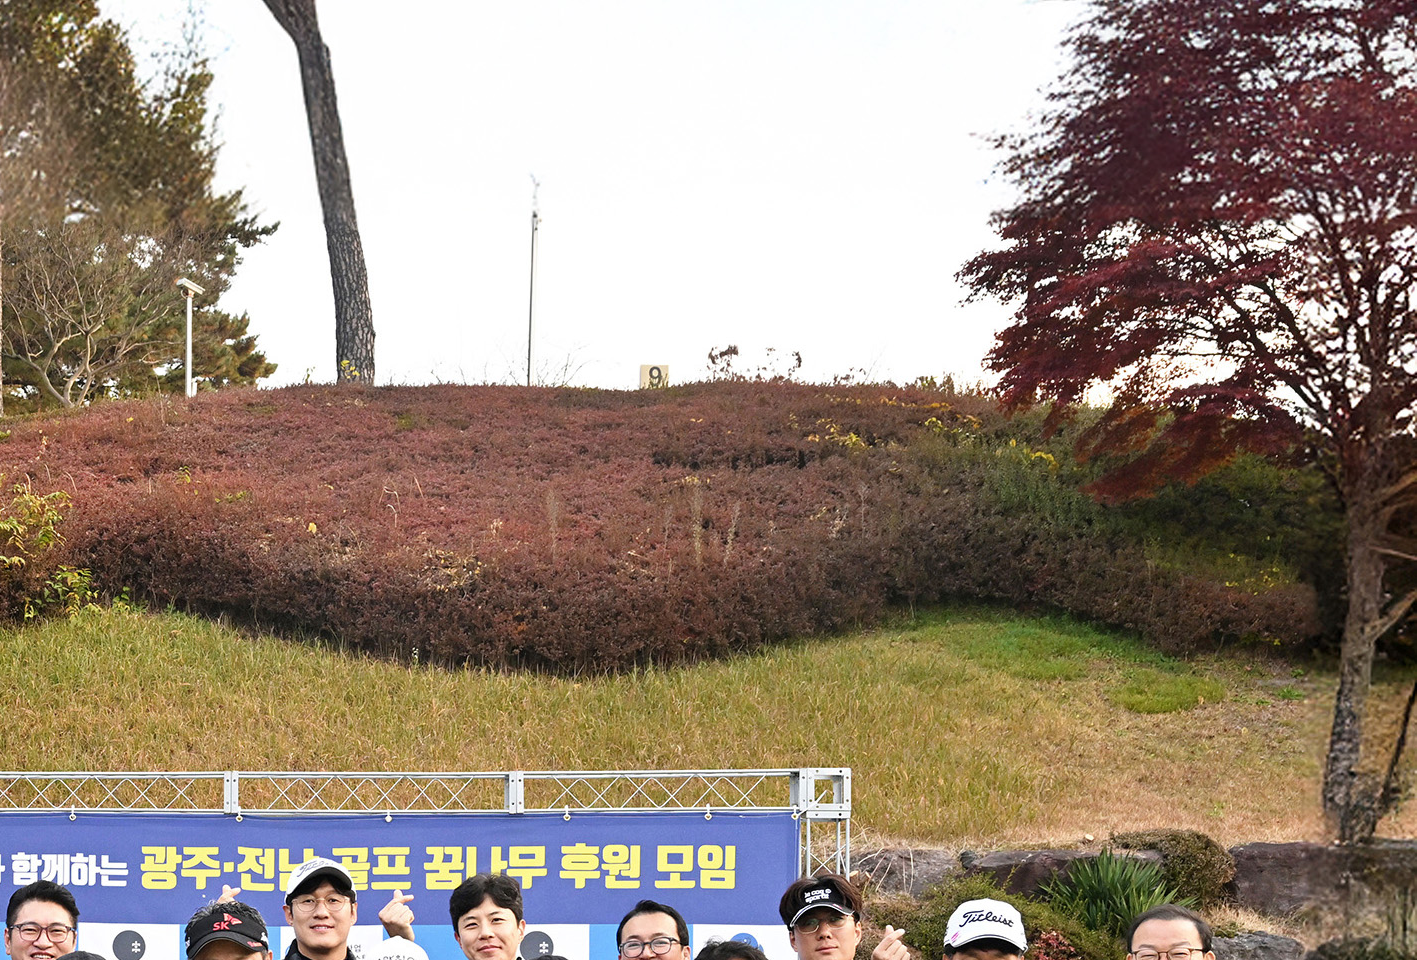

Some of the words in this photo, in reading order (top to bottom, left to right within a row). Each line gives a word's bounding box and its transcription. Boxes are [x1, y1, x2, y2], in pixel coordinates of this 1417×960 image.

[649, 366, 661, 386] 9
[12, 852, 128, 887] 함께하는
[333, 846, 411, 891] 골프
[560, 843, 640, 889] 후원
[656, 844, 736, 890] 모임
[213, 921, 230, 931] SK
[959, 910, 1014, 928] Titleist
